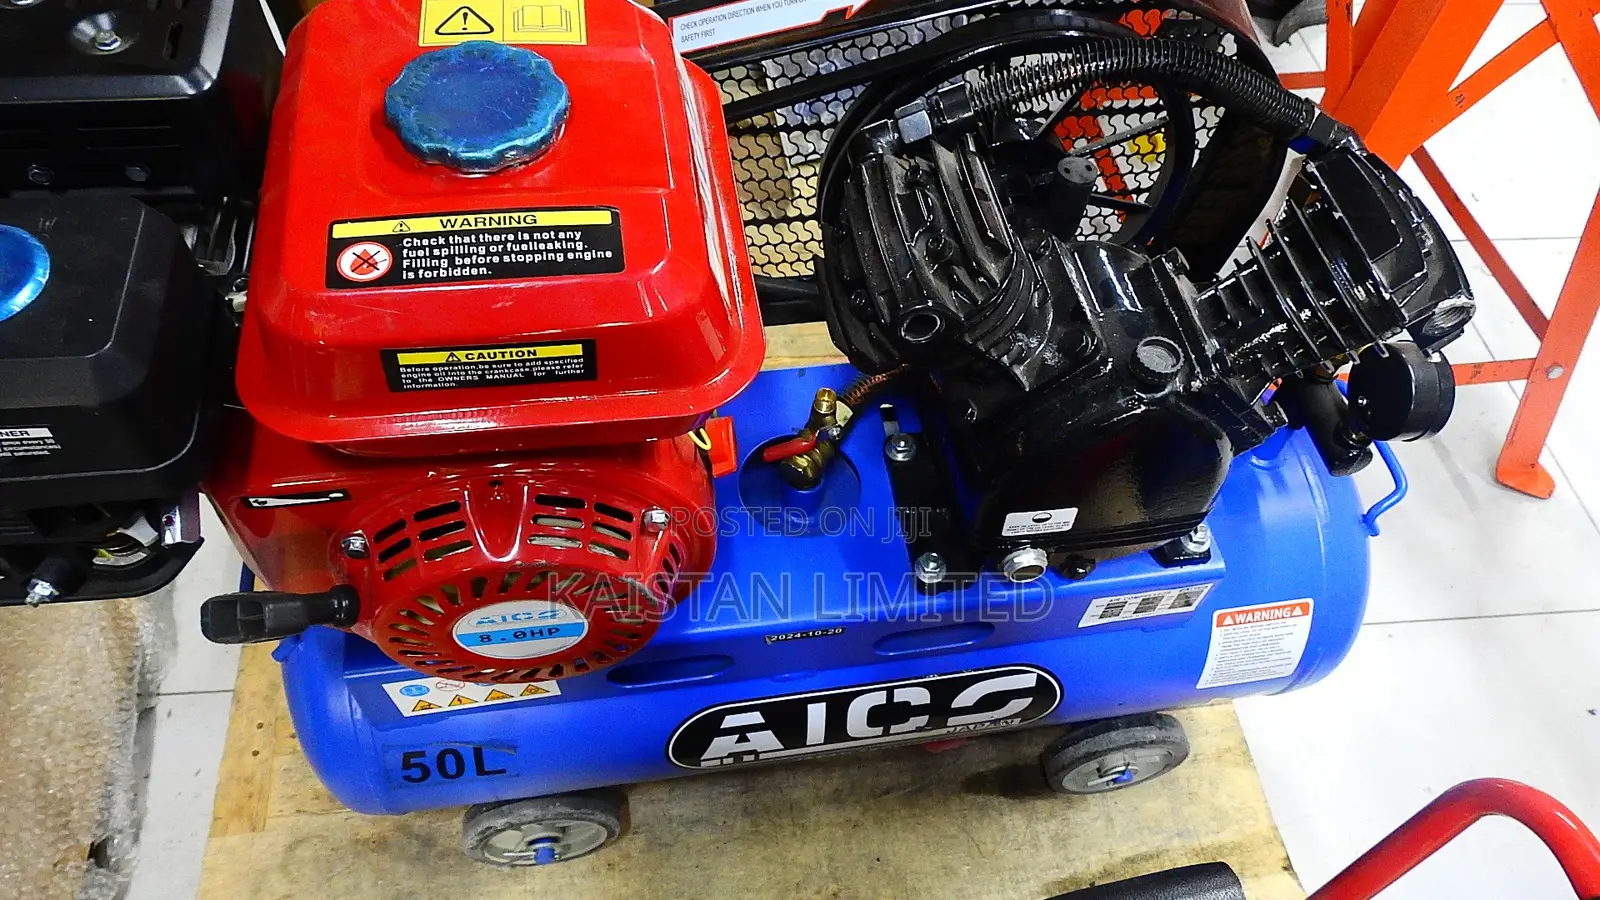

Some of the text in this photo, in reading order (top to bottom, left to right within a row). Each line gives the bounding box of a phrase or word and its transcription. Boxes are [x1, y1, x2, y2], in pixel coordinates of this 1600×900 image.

[680, 20, 698, 31] CHECK
[698, 13, 727, 27] OPERATION
[727, 7, 755, 20] DIRECTION
[755, 4, 771, 13] WHEN
[771, 1, 783, 9] YOU
[681, 28, 715, 43] SAFETY FIRST
[440, 214, 538, 229] WARNING
[402, 230, 582, 247] Check that there is not any
[402, 240, 589, 258] fuel spilling or fuelleaking.
[402, 249, 613, 269] Filling before stopping engine
[402, 266, 493, 279] is forbidden.
[464, 349, 538, 361] CAUTION
[543, 358, 584, 366] specified
[485, 372, 525, 380] MANUAL
[1234, 607, 1291, 624] WARNING
[479, 627, 560, 643] 8.0HP
[770, 627, 843, 642] 2024-10-20
[401, 746, 507, 784] 50L
